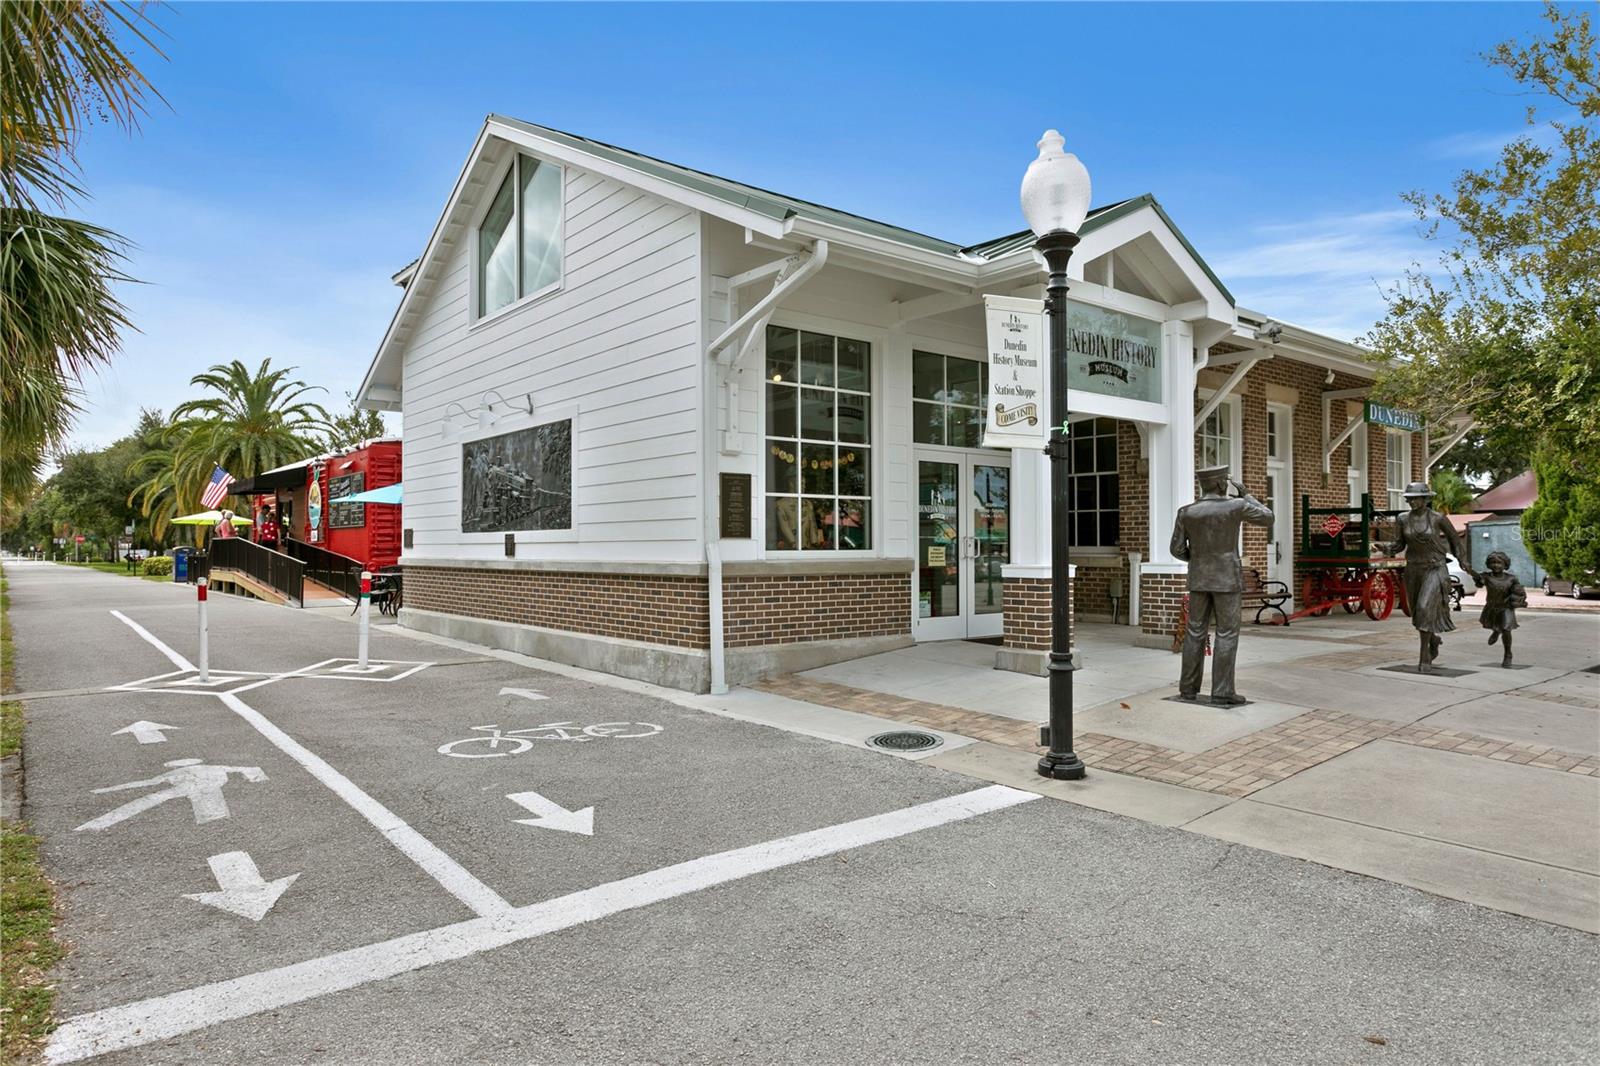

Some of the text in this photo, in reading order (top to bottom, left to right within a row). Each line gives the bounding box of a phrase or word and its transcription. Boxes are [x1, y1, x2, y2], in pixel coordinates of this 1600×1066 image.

[1004, 338, 1027, 352] Dunedin
[1066, 328, 1158, 369] UNEDIN HISTORY
[993, 353, 1038, 367] History Museum
[1012, 370, 1018, 381] &
[1094, 363, 1123, 377] MUSEUM
[994, 383, 1036, 399] Station Shoppe
[1000, 412, 1016, 424] COME
